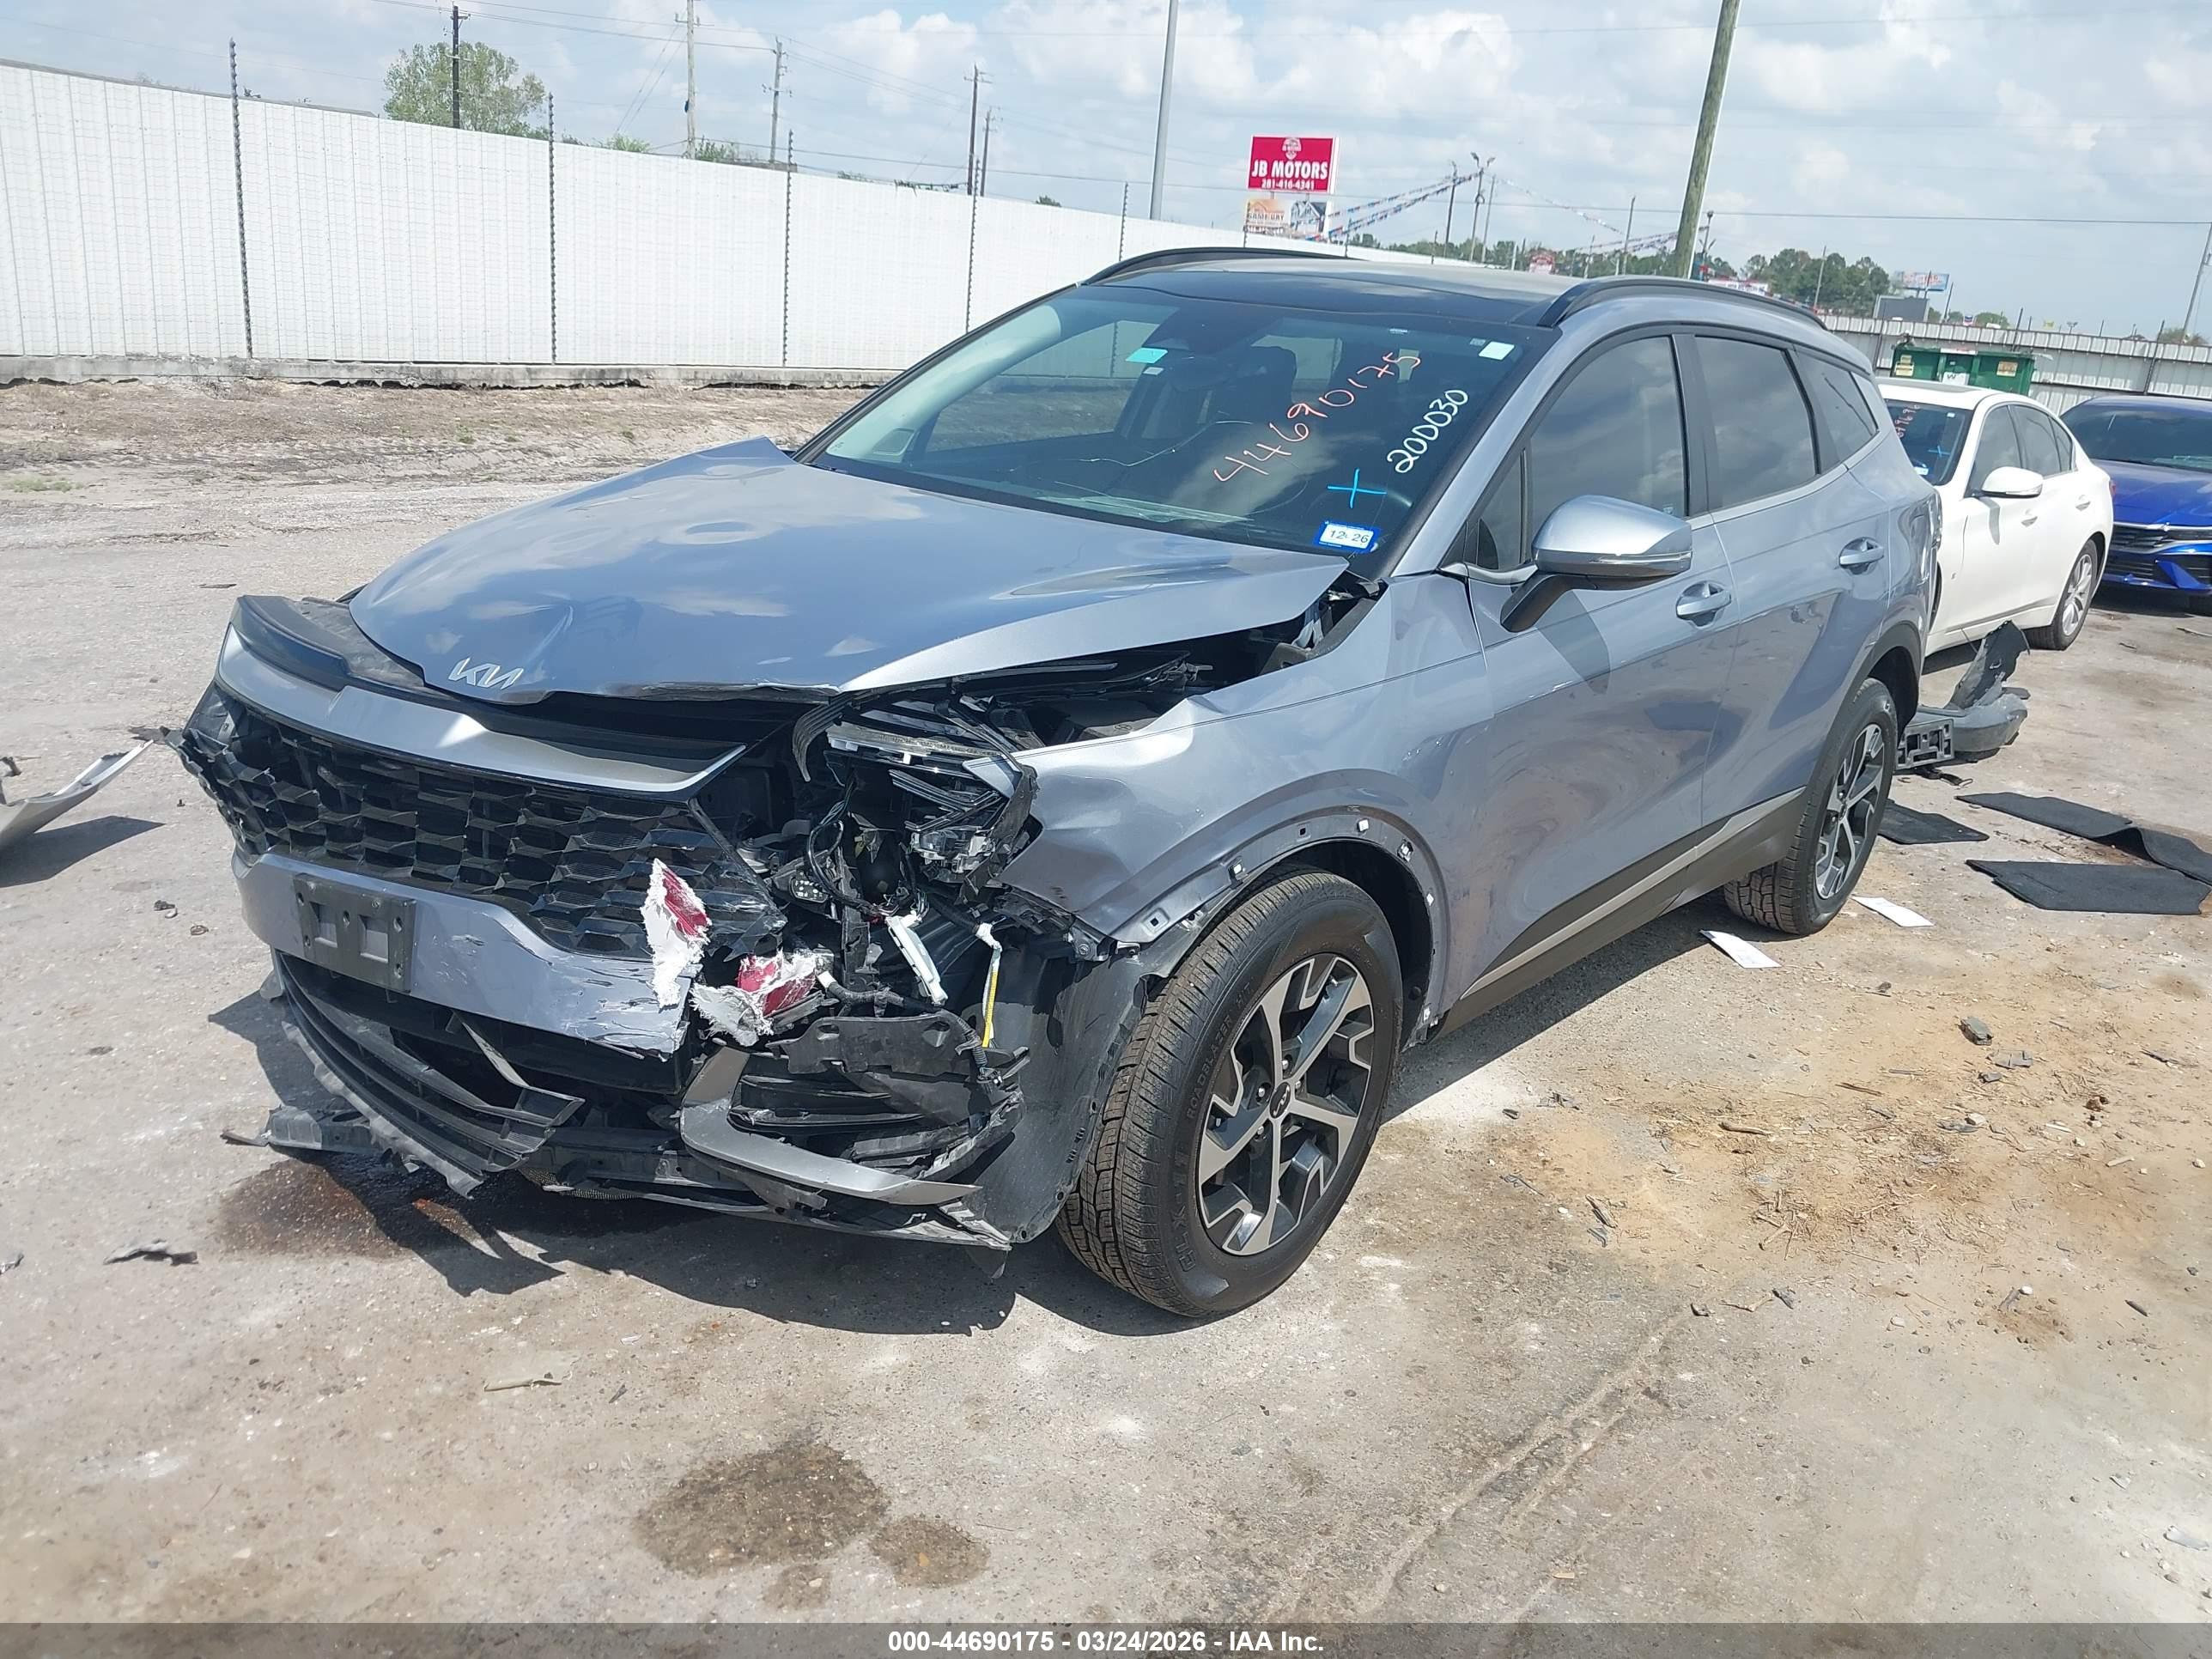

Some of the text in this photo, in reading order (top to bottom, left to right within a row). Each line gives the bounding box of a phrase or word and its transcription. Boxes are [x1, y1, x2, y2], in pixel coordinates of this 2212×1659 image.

[1251, 160, 1328, 179] JB MOTORS
[1212, 351, 1421, 482] 44690175
[1386, 388, 1469, 473] 200030
[1352, 533, 1370, 543] 26
